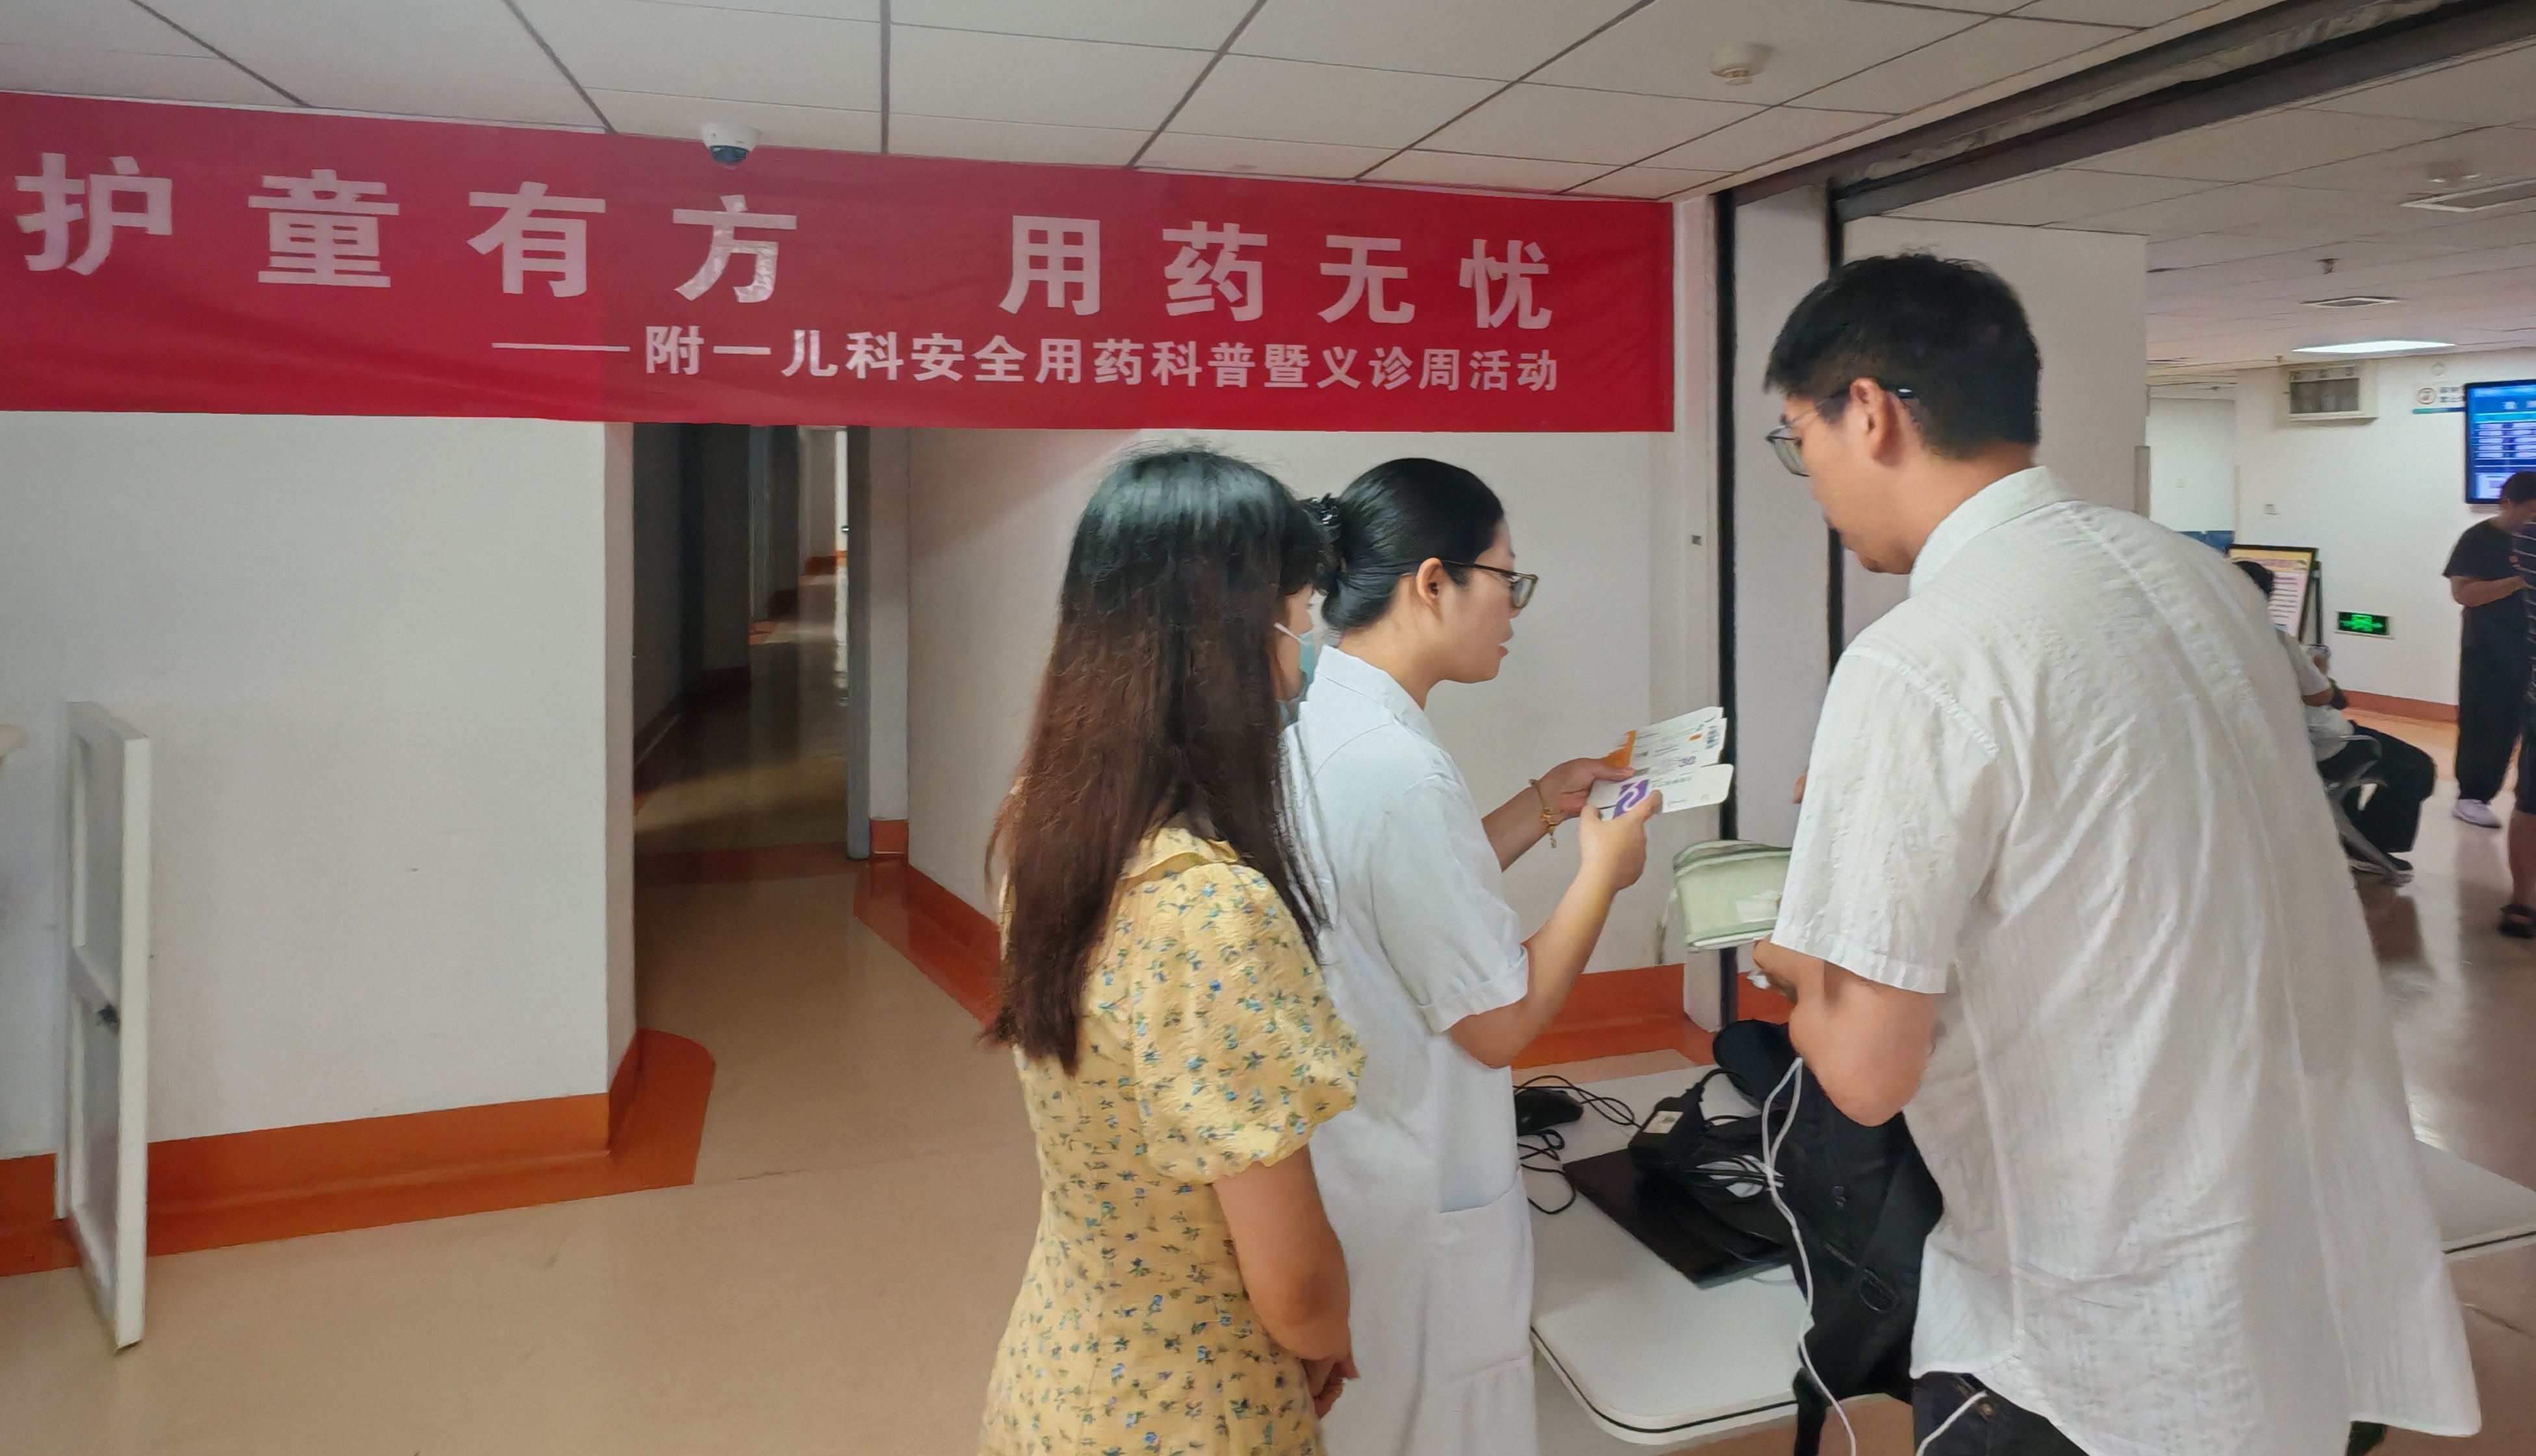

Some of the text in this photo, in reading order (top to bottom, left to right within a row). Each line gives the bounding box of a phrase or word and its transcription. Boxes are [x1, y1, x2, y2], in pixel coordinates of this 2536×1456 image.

[14, 151, 1553, 330] 护童有方 用药无忧
